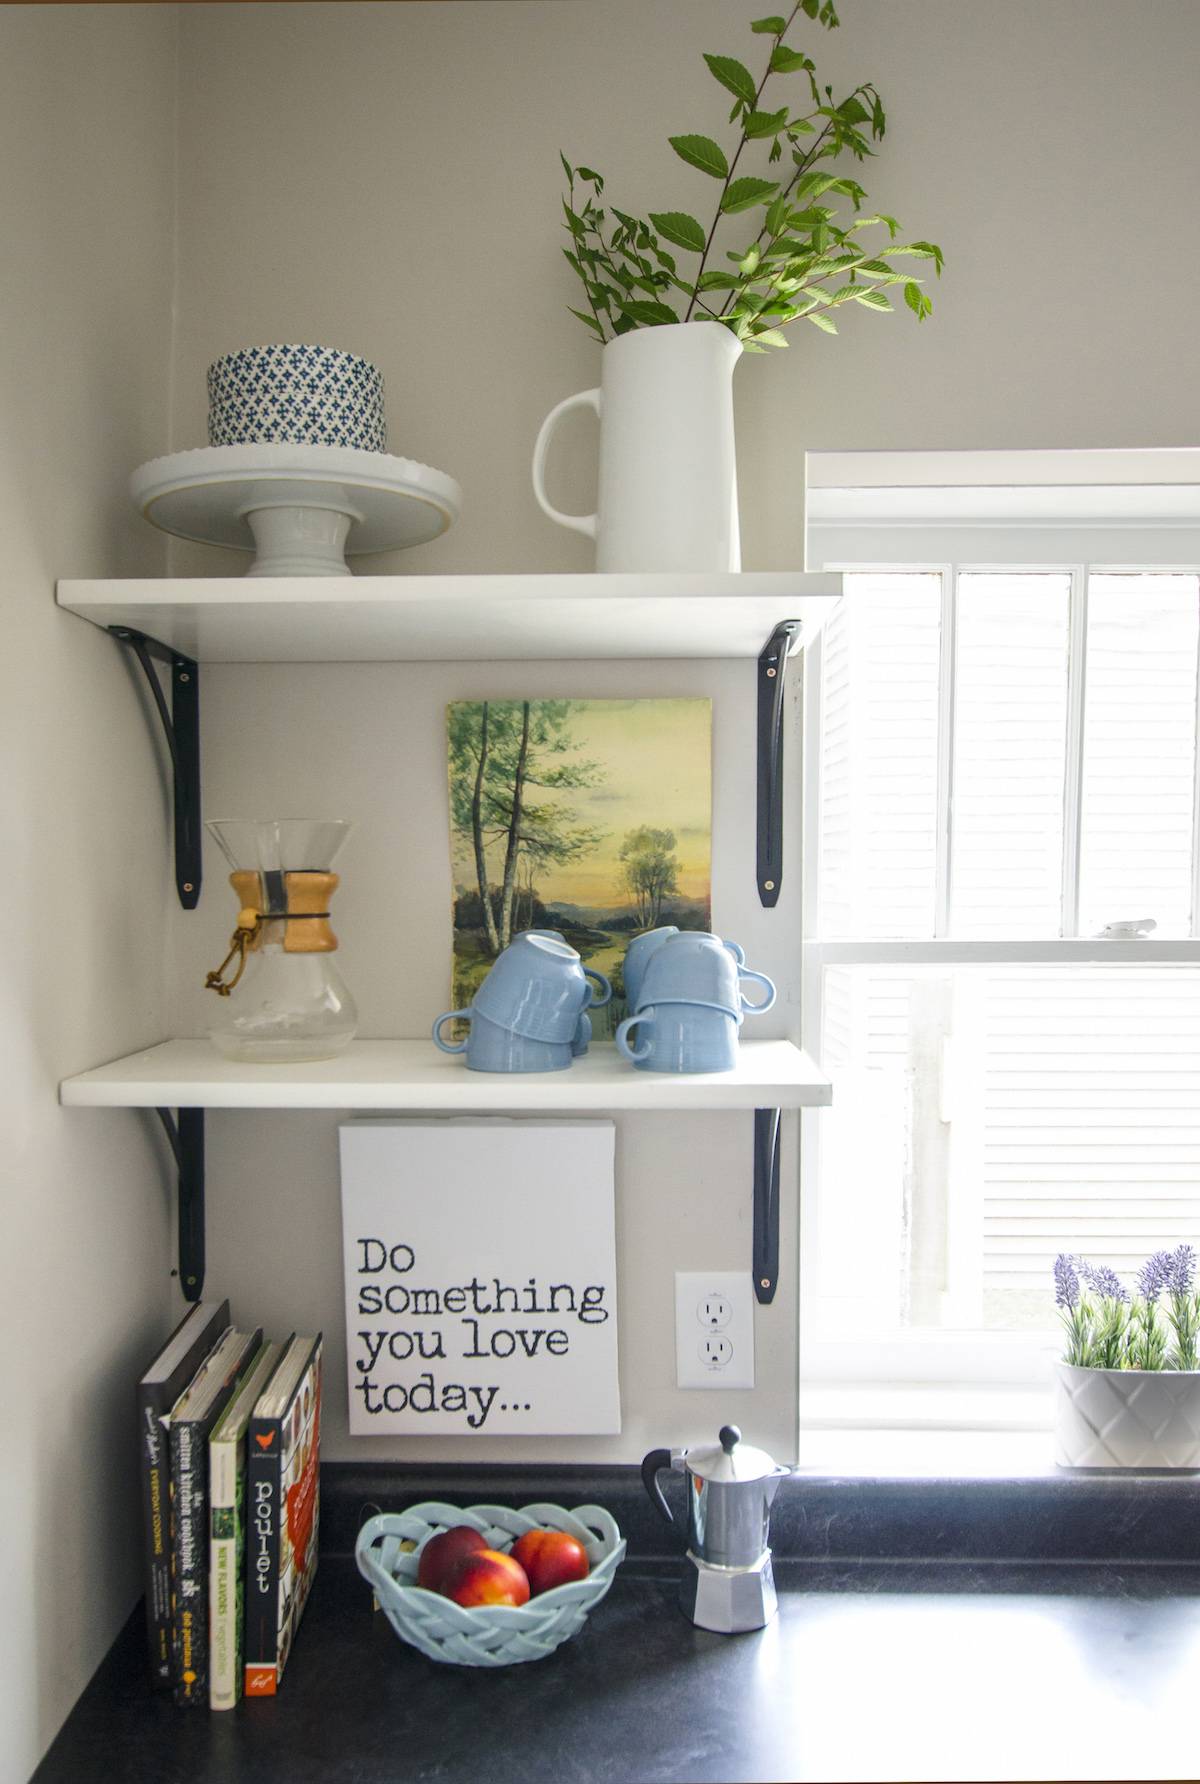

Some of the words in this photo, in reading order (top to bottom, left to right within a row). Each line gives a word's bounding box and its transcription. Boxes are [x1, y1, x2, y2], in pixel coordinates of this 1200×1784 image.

[357, 1238, 415, 1273] Do
[358, 1278, 609, 1324] something
[356, 1331, 447, 1373] you
[461, 1318, 569, 1358] love
[355, 1373, 531, 1428] today...
[180, 1426, 192, 1471] smitten
[150, 1469, 160, 1512] EVERYDAY
[180, 1473, 193, 1515] kitchen
[153, 1513, 163, 1555] COOKING
[254, 1482, 273, 1594] poulet
[218, 1547, 227, 1568] NEW
[217, 1573, 227, 1616] FLAVORS
